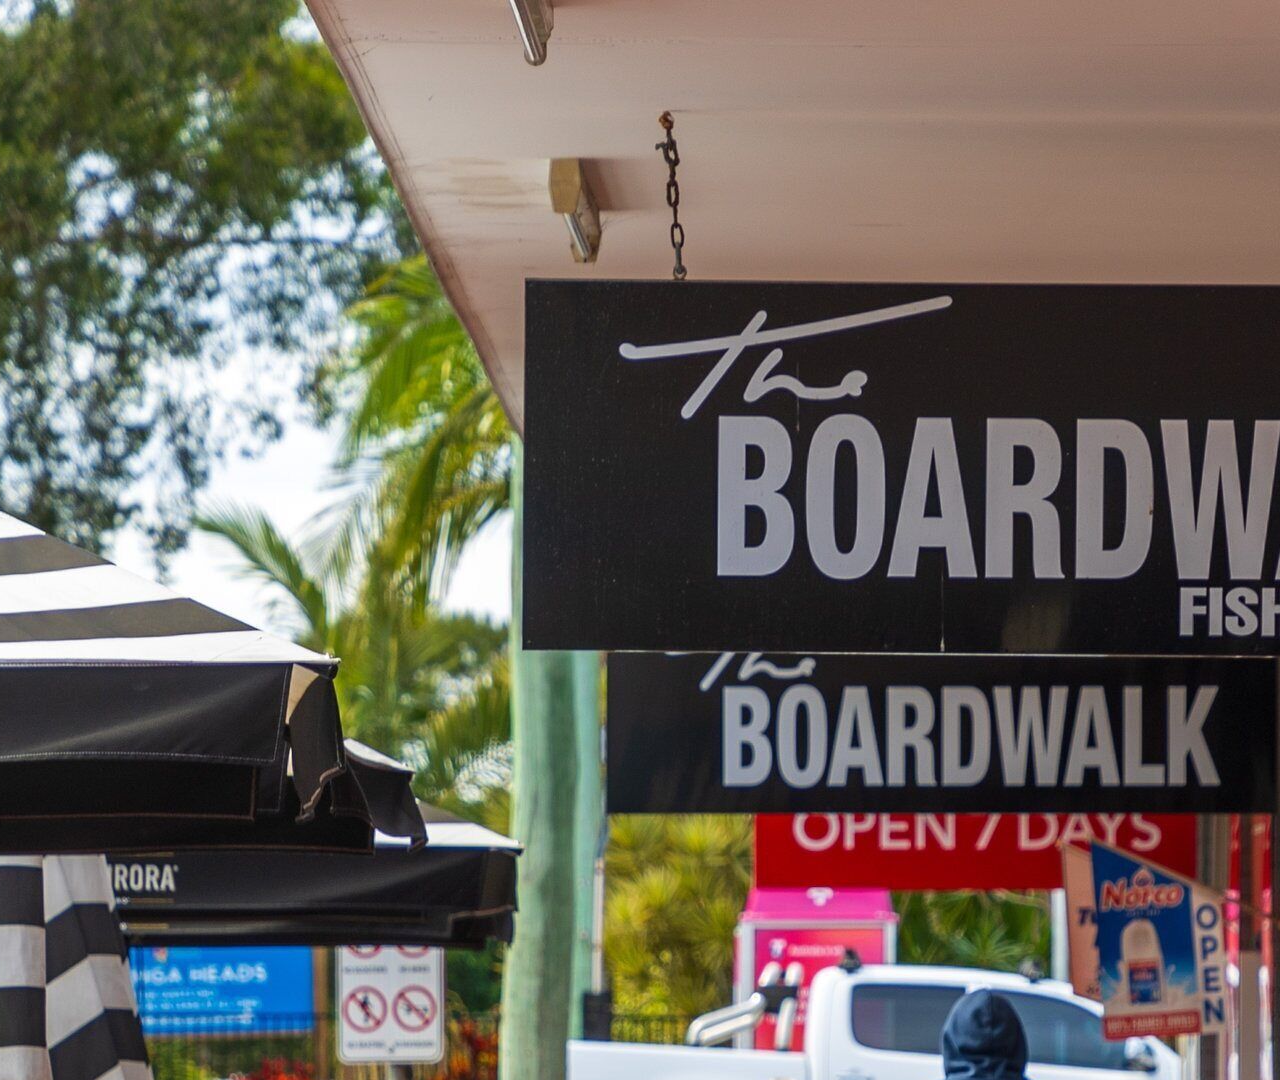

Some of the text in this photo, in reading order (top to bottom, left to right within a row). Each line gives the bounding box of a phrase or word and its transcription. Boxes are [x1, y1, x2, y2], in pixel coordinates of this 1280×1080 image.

[619, 295, 953, 420] The
[723, 684, 1221, 788] BOARDWALK
[791, 812, 1164, 853] OPEN 7 DAYS
[109, 863, 176, 893] RORA
[1101, 876, 1184, 911] Norco
[1197, 904, 1225, 1023] OPEN
